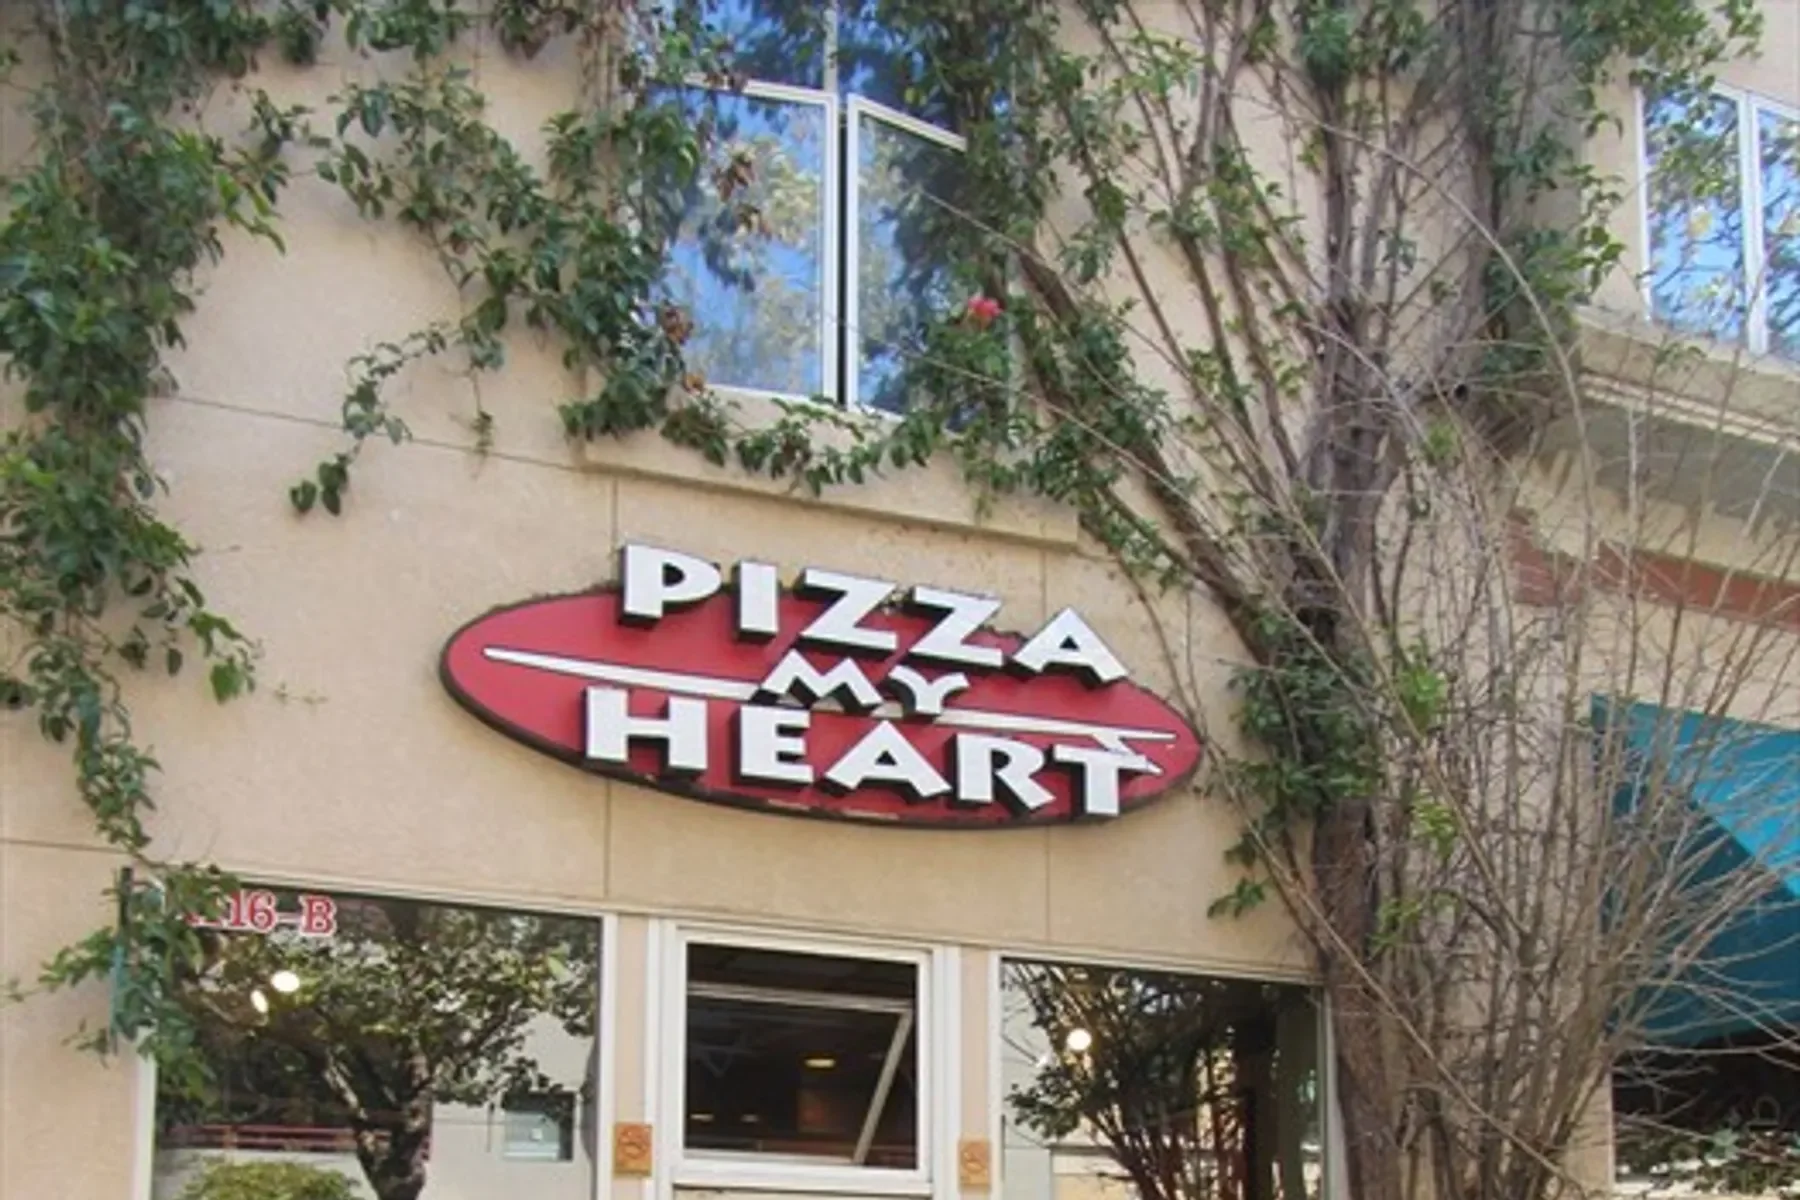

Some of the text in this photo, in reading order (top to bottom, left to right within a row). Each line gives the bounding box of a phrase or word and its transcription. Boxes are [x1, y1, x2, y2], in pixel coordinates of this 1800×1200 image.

[620, 543, 1128, 684] PIZZA
[758, 648, 970, 716] MY
[583, 686, 1150, 816] HEART
